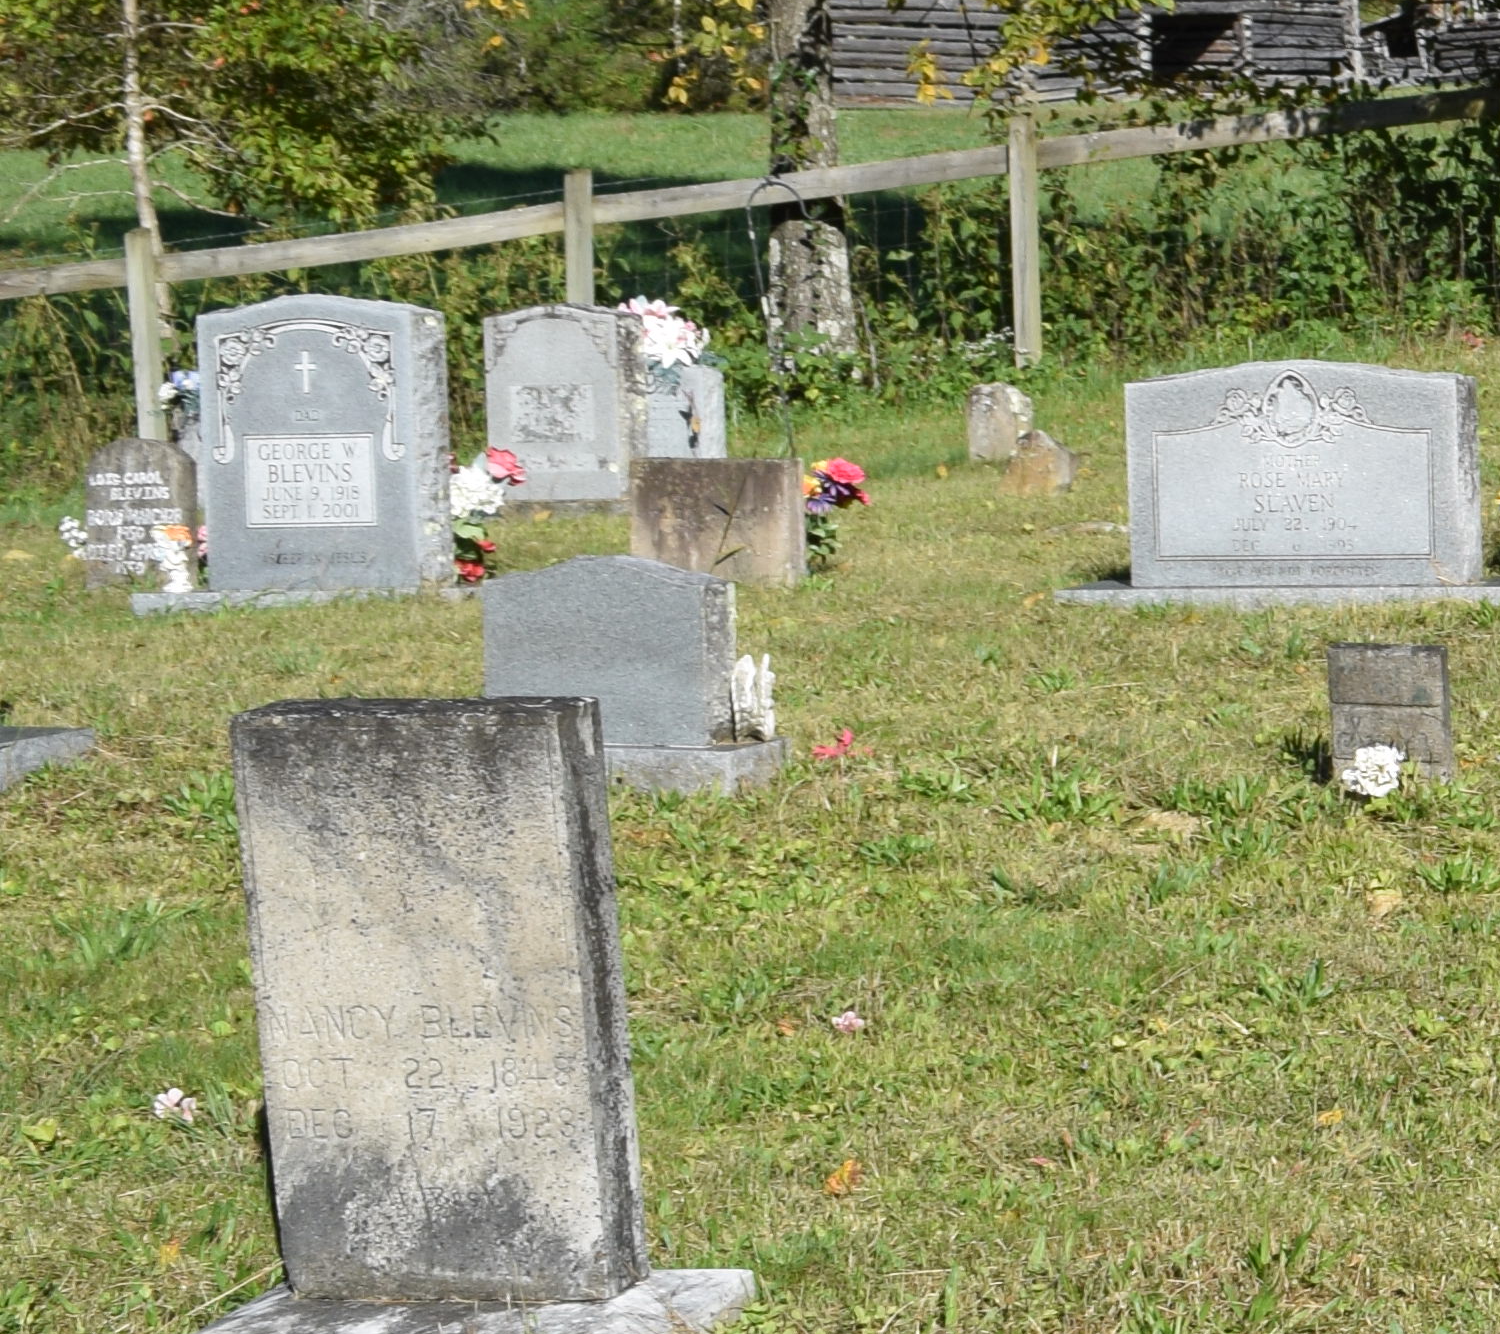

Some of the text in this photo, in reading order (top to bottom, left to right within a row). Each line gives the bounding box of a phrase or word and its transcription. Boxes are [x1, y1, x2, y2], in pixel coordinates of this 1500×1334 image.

[258, 443, 331, 460] GEORGE
[268, 464, 352, 483] BLEVINS
[1239, 471, 1343, 489] ROSE MARY
[110, 487, 170, 500] BLEVINS
[262, 487, 303, 501] JUNE
[323, 504, 360, 517] 2001
[1253, 494, 1335, 513] SLAVEN
[268, 1003, 577, 1043] NANCY BLEVINS
[282, 1056, 354, 1089] OCT
[286, 1107, 354, 1139] DEC
